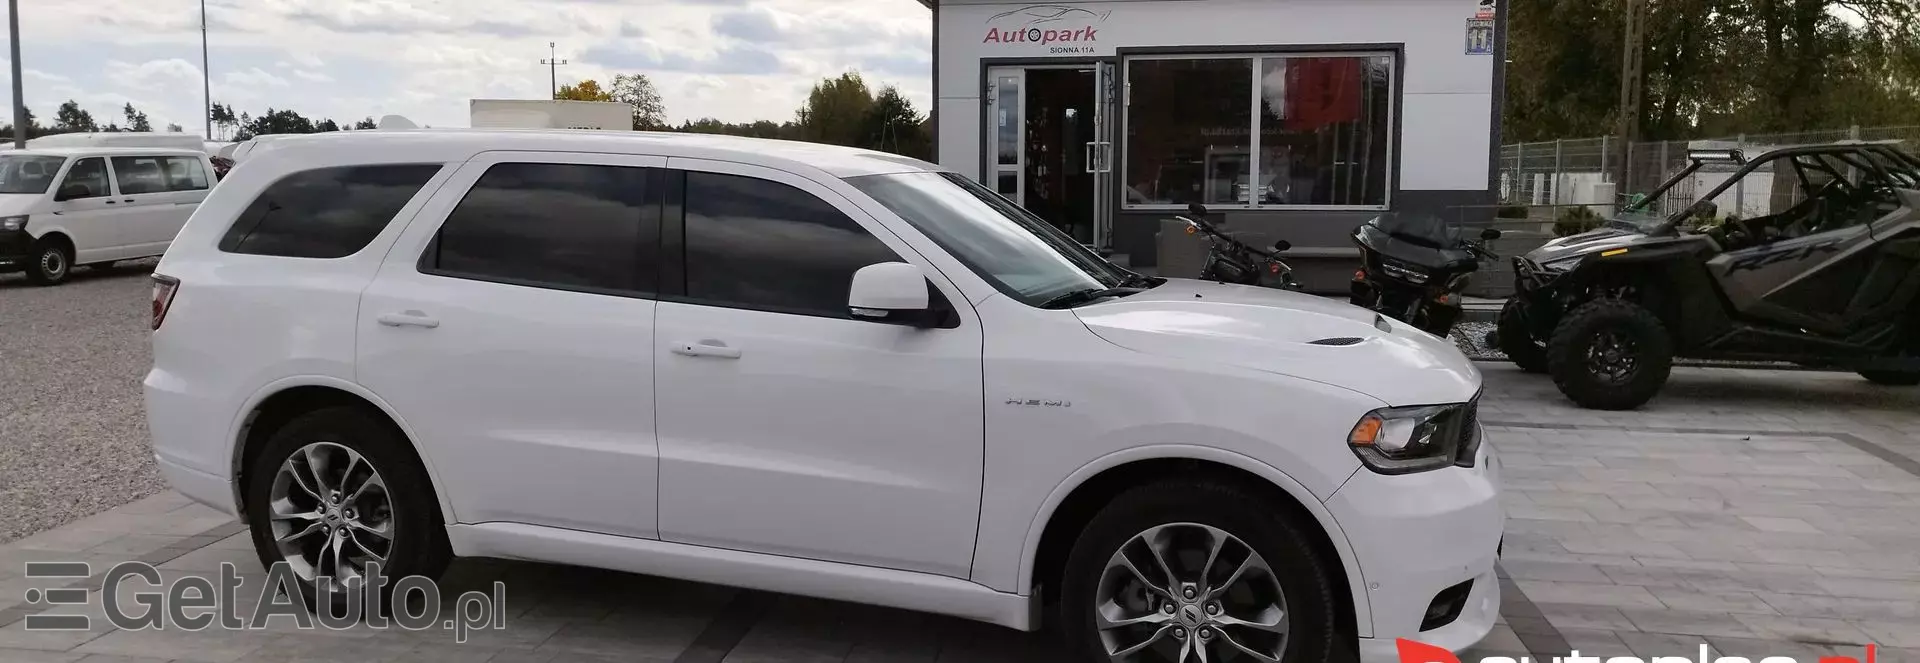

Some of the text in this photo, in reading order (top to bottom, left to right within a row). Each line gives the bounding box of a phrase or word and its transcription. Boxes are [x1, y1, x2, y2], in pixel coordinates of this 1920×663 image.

[983, 26, 1098, 45] Autopark
[1050, 46, 1095, 54] SIONNA 11A
